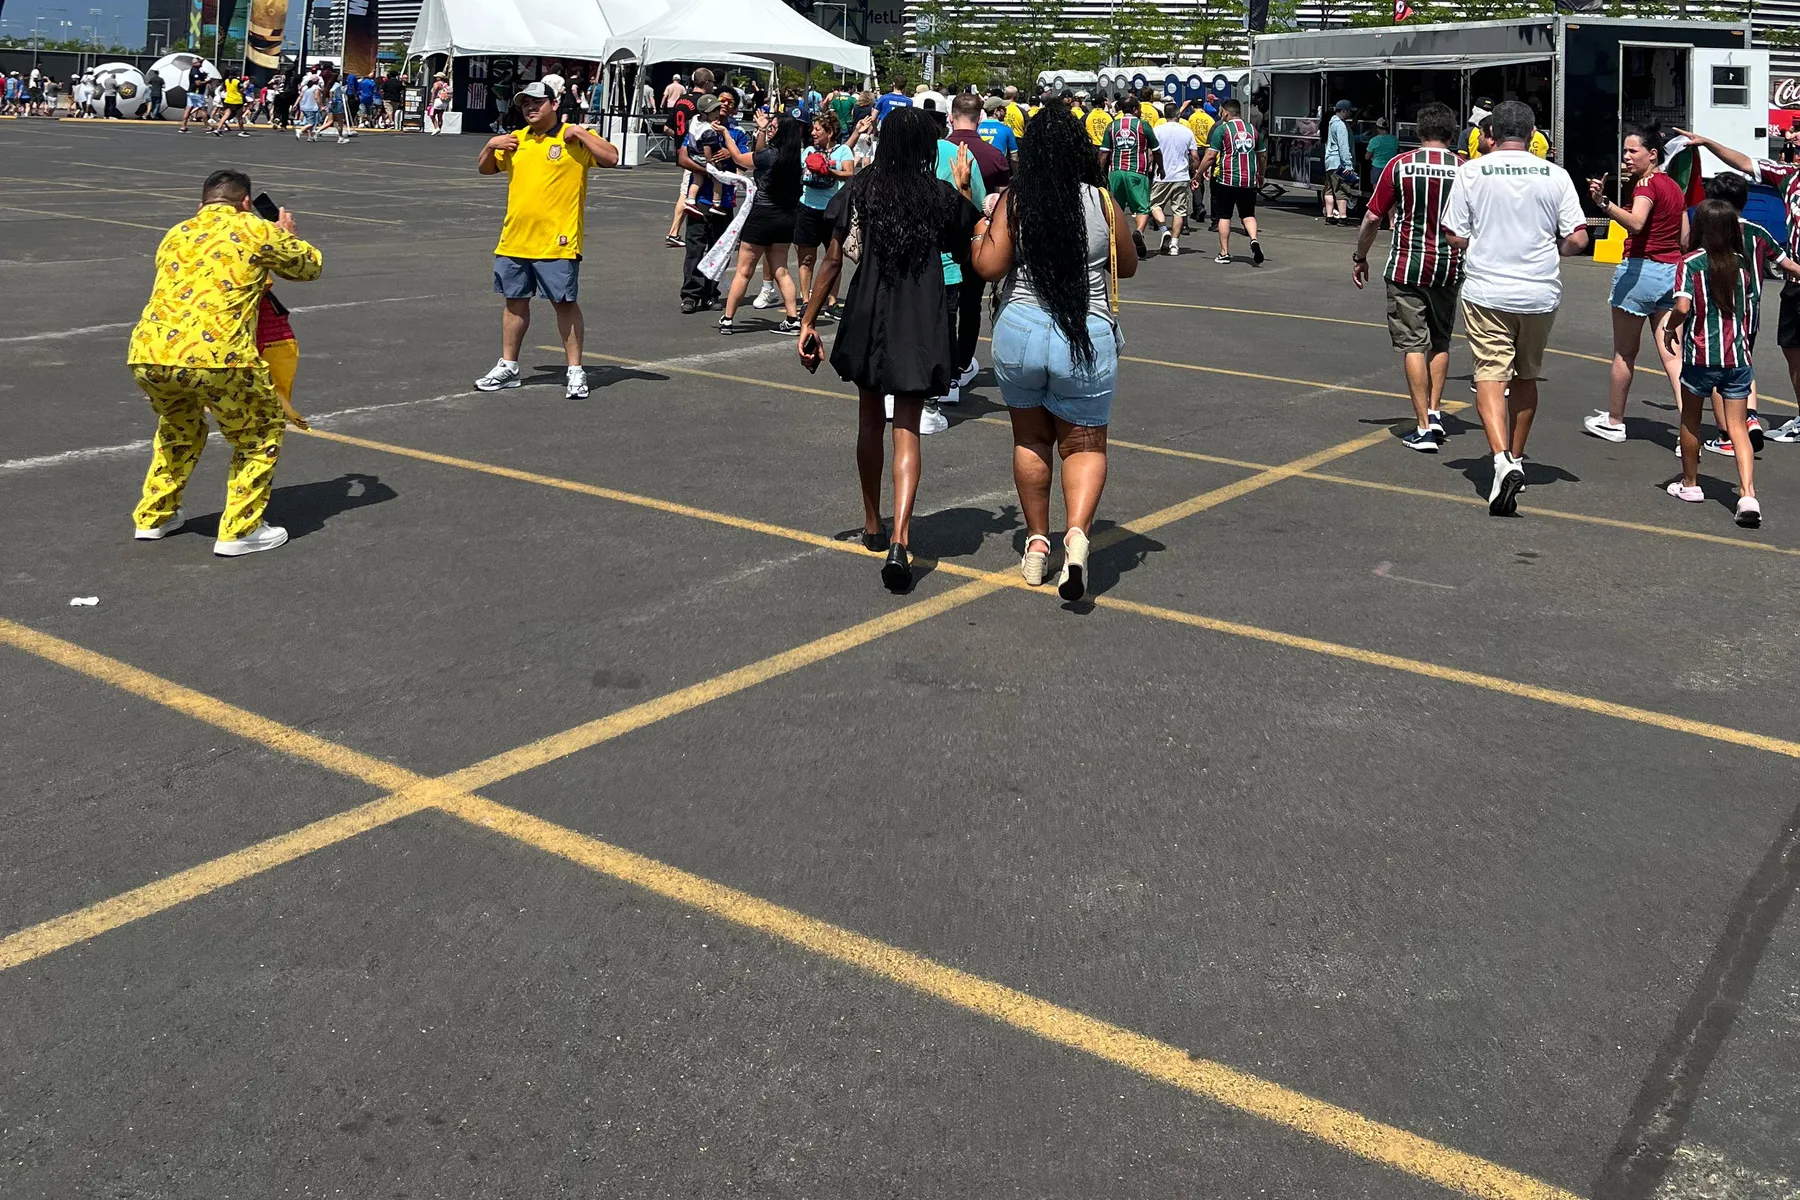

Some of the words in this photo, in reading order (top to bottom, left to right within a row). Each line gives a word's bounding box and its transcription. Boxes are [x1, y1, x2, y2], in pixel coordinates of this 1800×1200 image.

[866, 9, 908, 24] MetLi
[1404, 164, 1456, 178] Unime
[1481, 164, 1550, 177] Unimed
